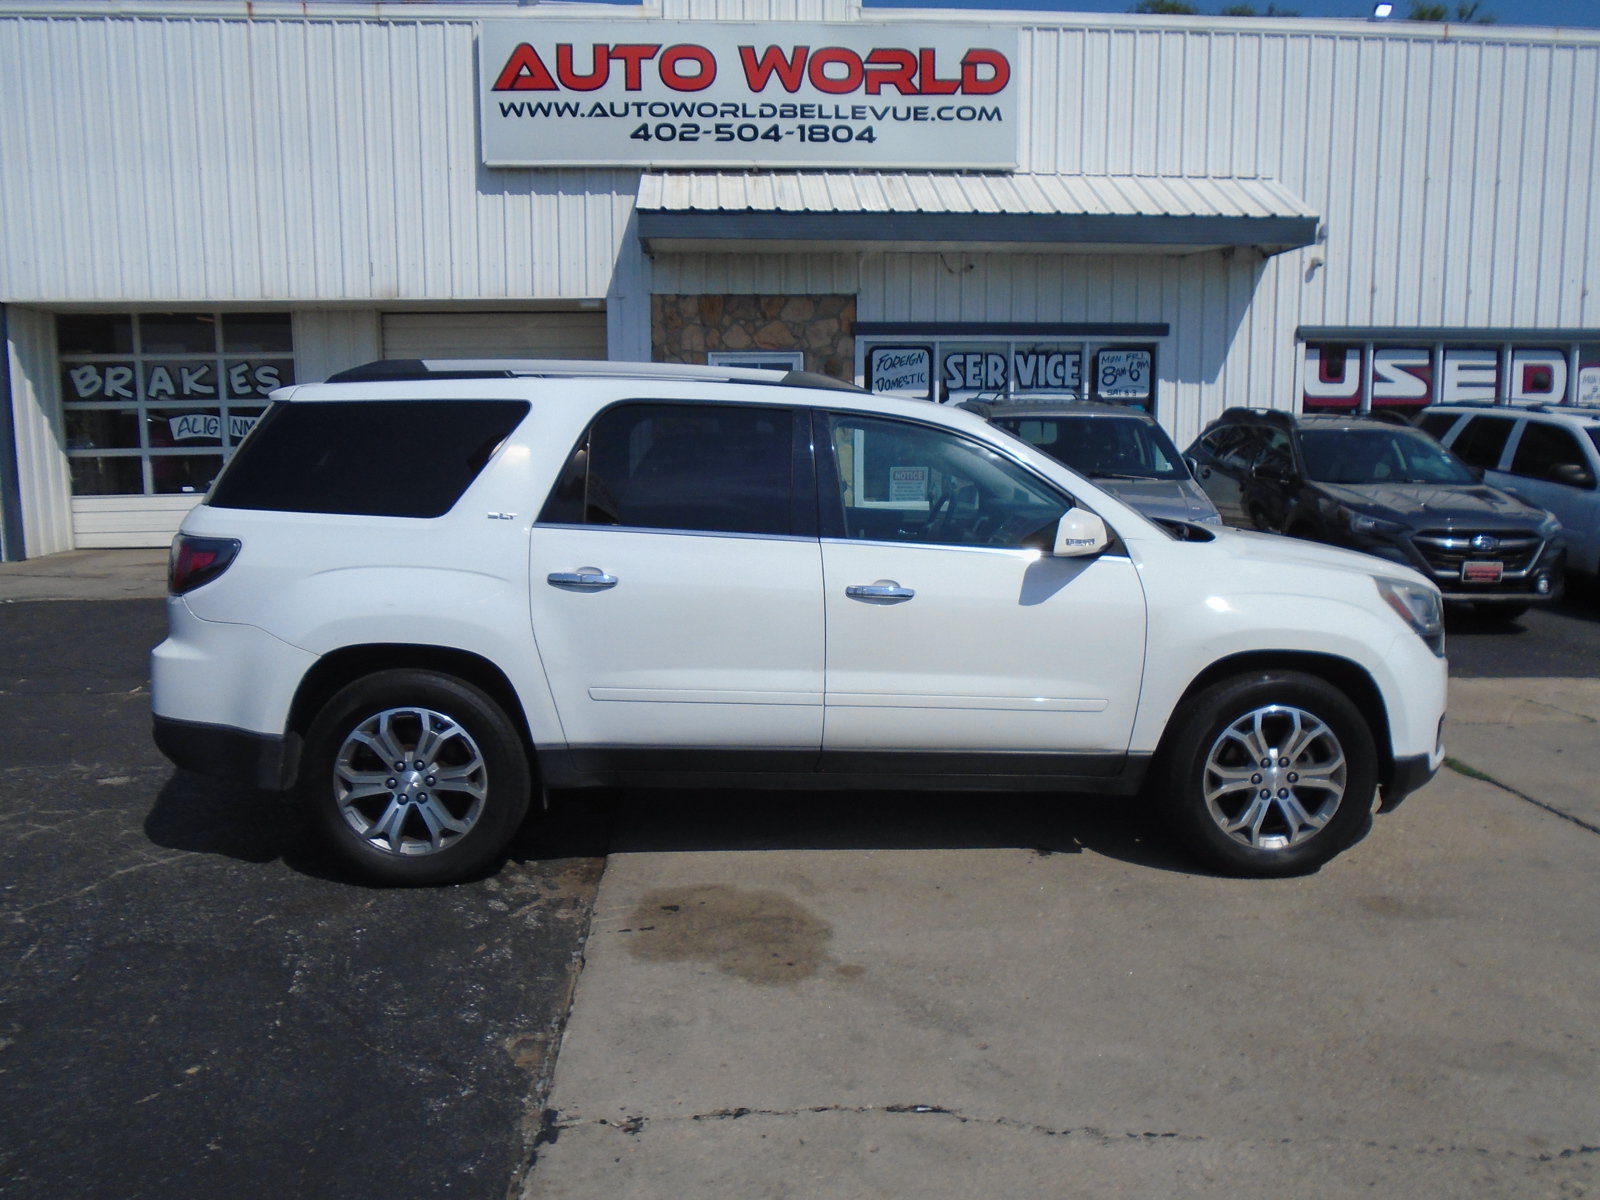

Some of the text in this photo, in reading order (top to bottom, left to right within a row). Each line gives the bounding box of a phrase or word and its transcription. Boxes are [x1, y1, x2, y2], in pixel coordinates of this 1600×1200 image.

[490, 42, 1011, 96] AUTO WORLD
[499, 101, 1003, 122] WWW.AUTOWORLDBELLEVUE.COM
[629, 122, 877, 144] 402-504-1804
[876, 351, 925, 372] FOREIGN
[943, 351, 1083, 390] SERVICE
[69, 363, 282, 398] BRAKES
[875, 372, 926, 393] DOMESTIC
[1303, 348, 1568, 406] USED
[894, 471, 923, 480] NOTICE
